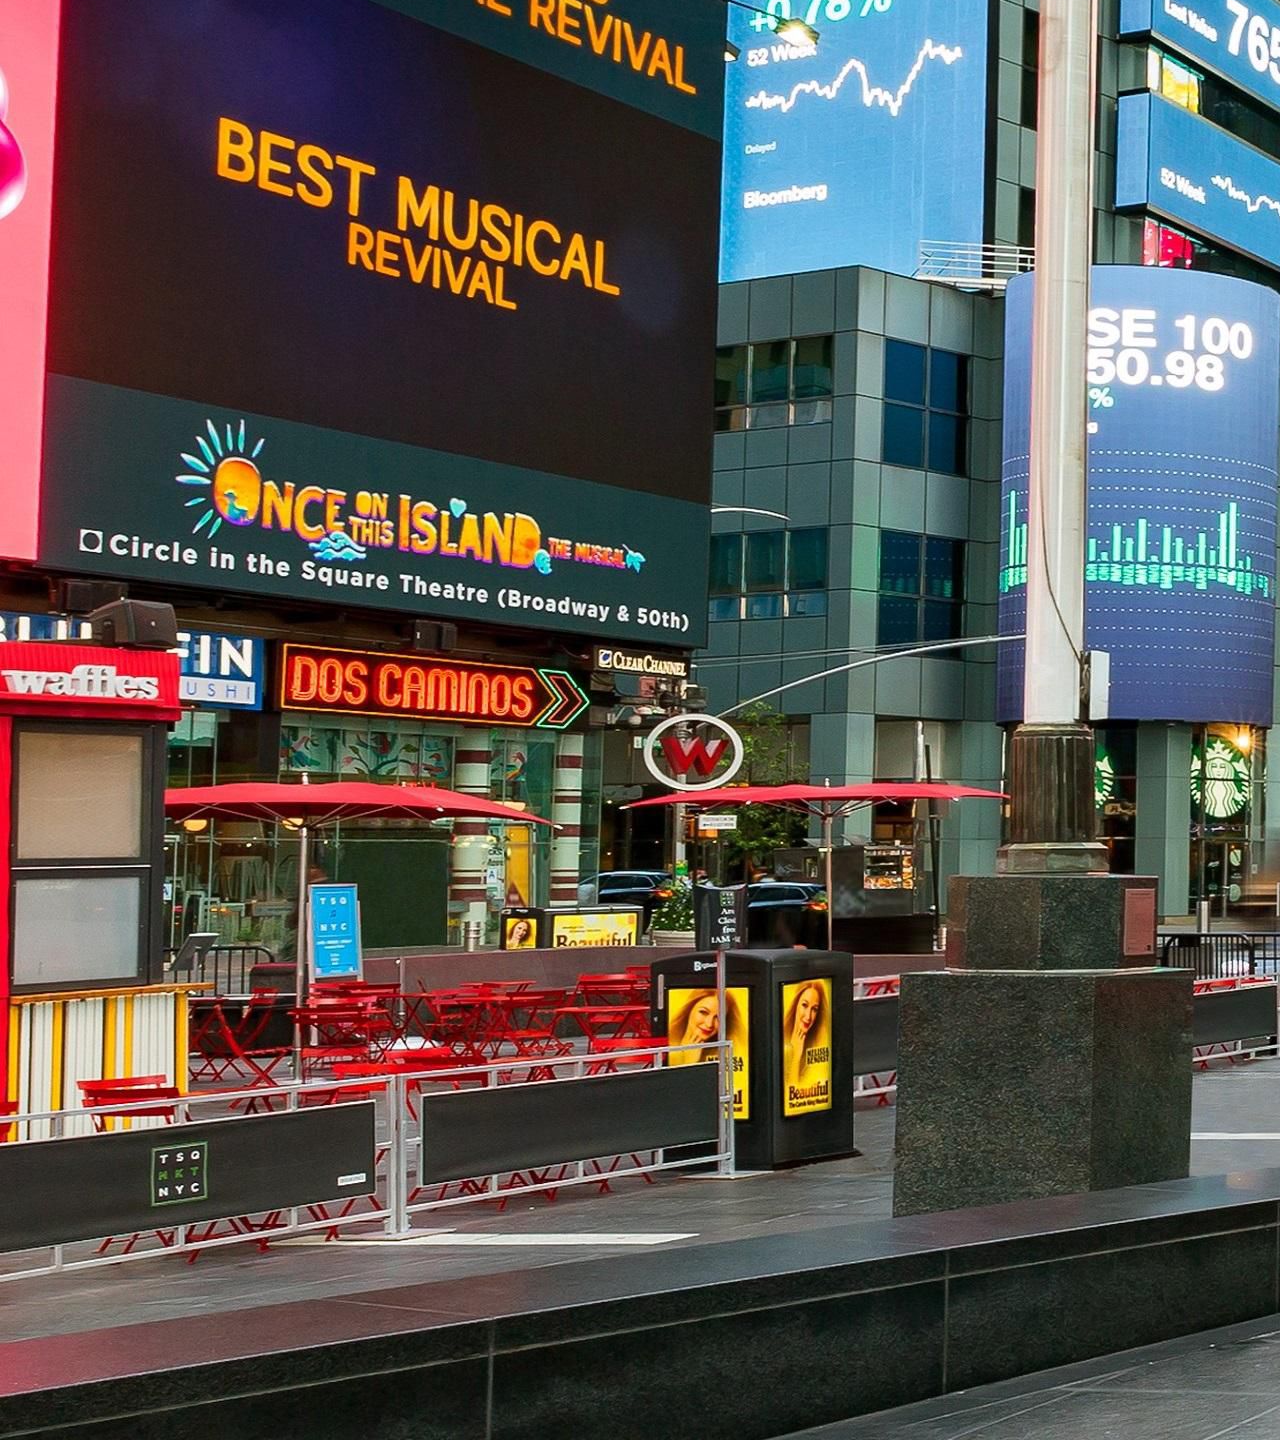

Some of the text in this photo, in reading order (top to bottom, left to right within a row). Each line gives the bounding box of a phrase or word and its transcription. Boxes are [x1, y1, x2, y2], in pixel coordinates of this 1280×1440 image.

[747, 50, 768, 66] 52
[744, 183, 827, 208] Bloomberg
[1160, 167, 1175, 188] 52
[216, 117, 621, 297] BEST MUSICAL
[347, 223, 517, 311] REVIVAL
[1175, 317, 1254, 359] 100
[213, 456, 627, 570] ONCE ON THIS ISLAND THE MUSICAL
[110, 533, 690, 633] Circle in the Square Theatre (Broadway & 50th)
[2, 664, 160, 699] waffles
[292, 655, 535, 718] DOS CAMINOS
[660, 736, 729, 776] W
[789, 1081, 829, 1102] Beautiful
